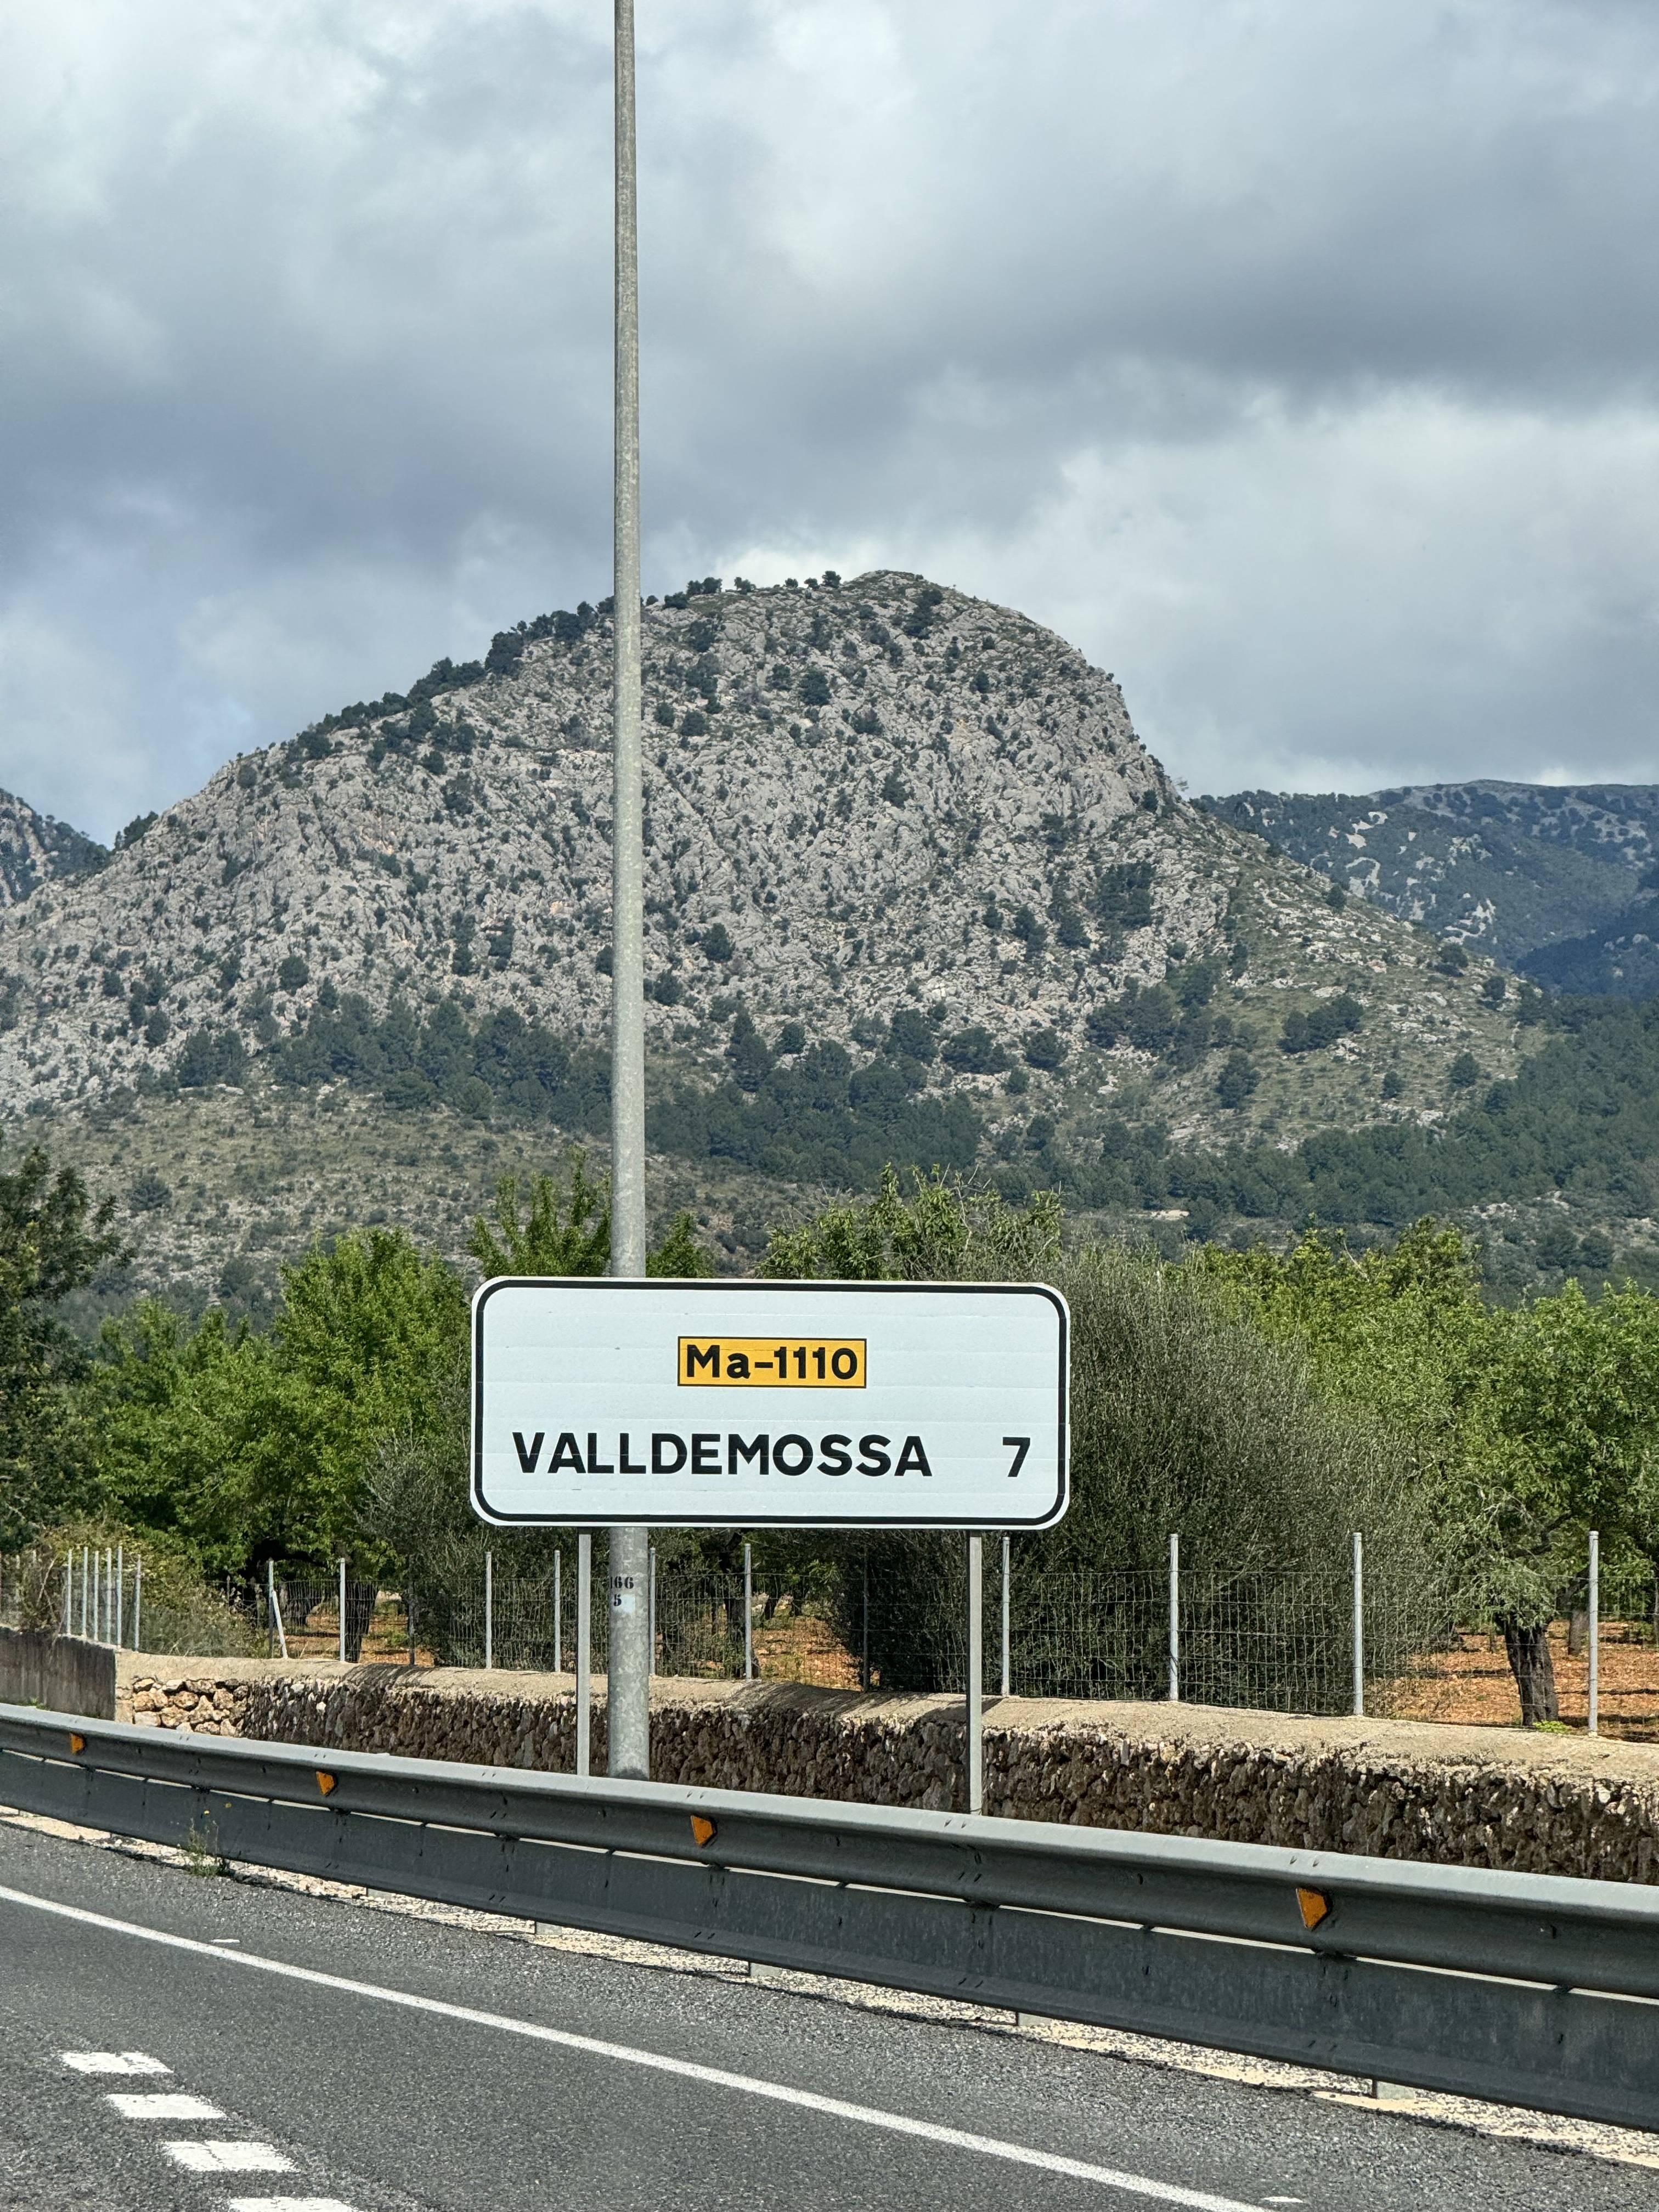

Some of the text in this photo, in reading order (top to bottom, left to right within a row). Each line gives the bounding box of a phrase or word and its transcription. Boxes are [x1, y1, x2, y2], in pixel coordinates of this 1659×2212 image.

[686, 1344, 858, 1380] Ma-1110
[512, 1432, 1031, 1477] VALLDEMOSSA 7
[613, 1594, 622, 1606] 5
